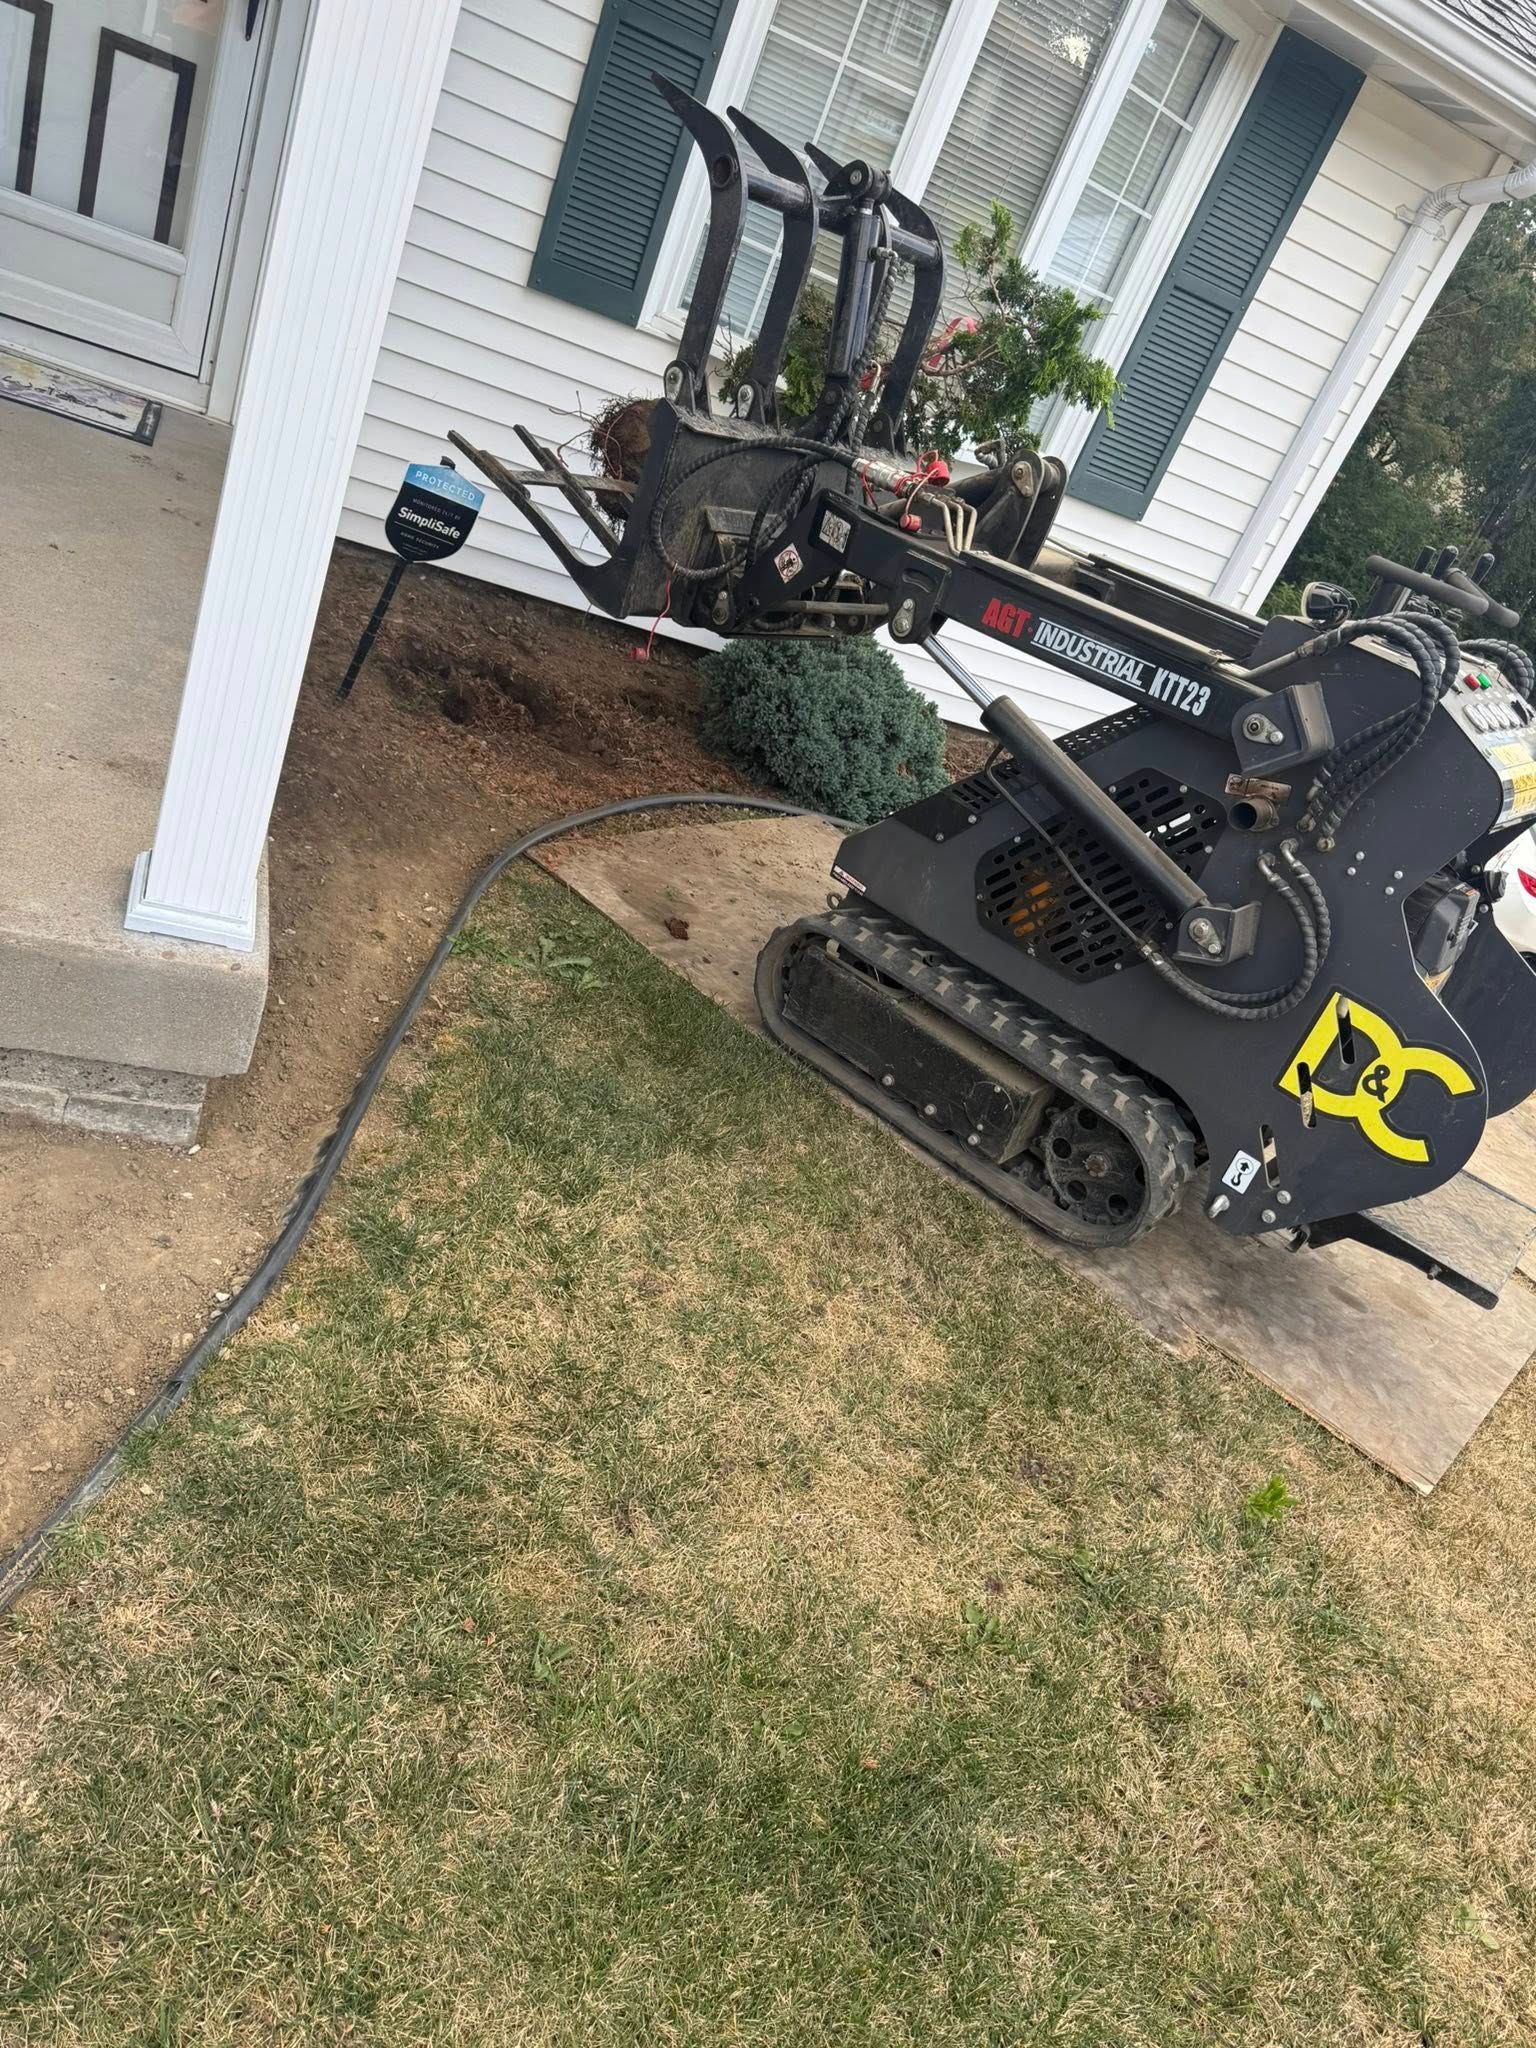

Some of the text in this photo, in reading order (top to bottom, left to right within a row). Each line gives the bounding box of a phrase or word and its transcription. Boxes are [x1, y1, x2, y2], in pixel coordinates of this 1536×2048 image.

[415, 470, 476, 501] PROTECTED
[398, 506, 461, 539] SimpliSafe
[981, 598, 1211, 717] AGT INDUSTRIAL KTT23
